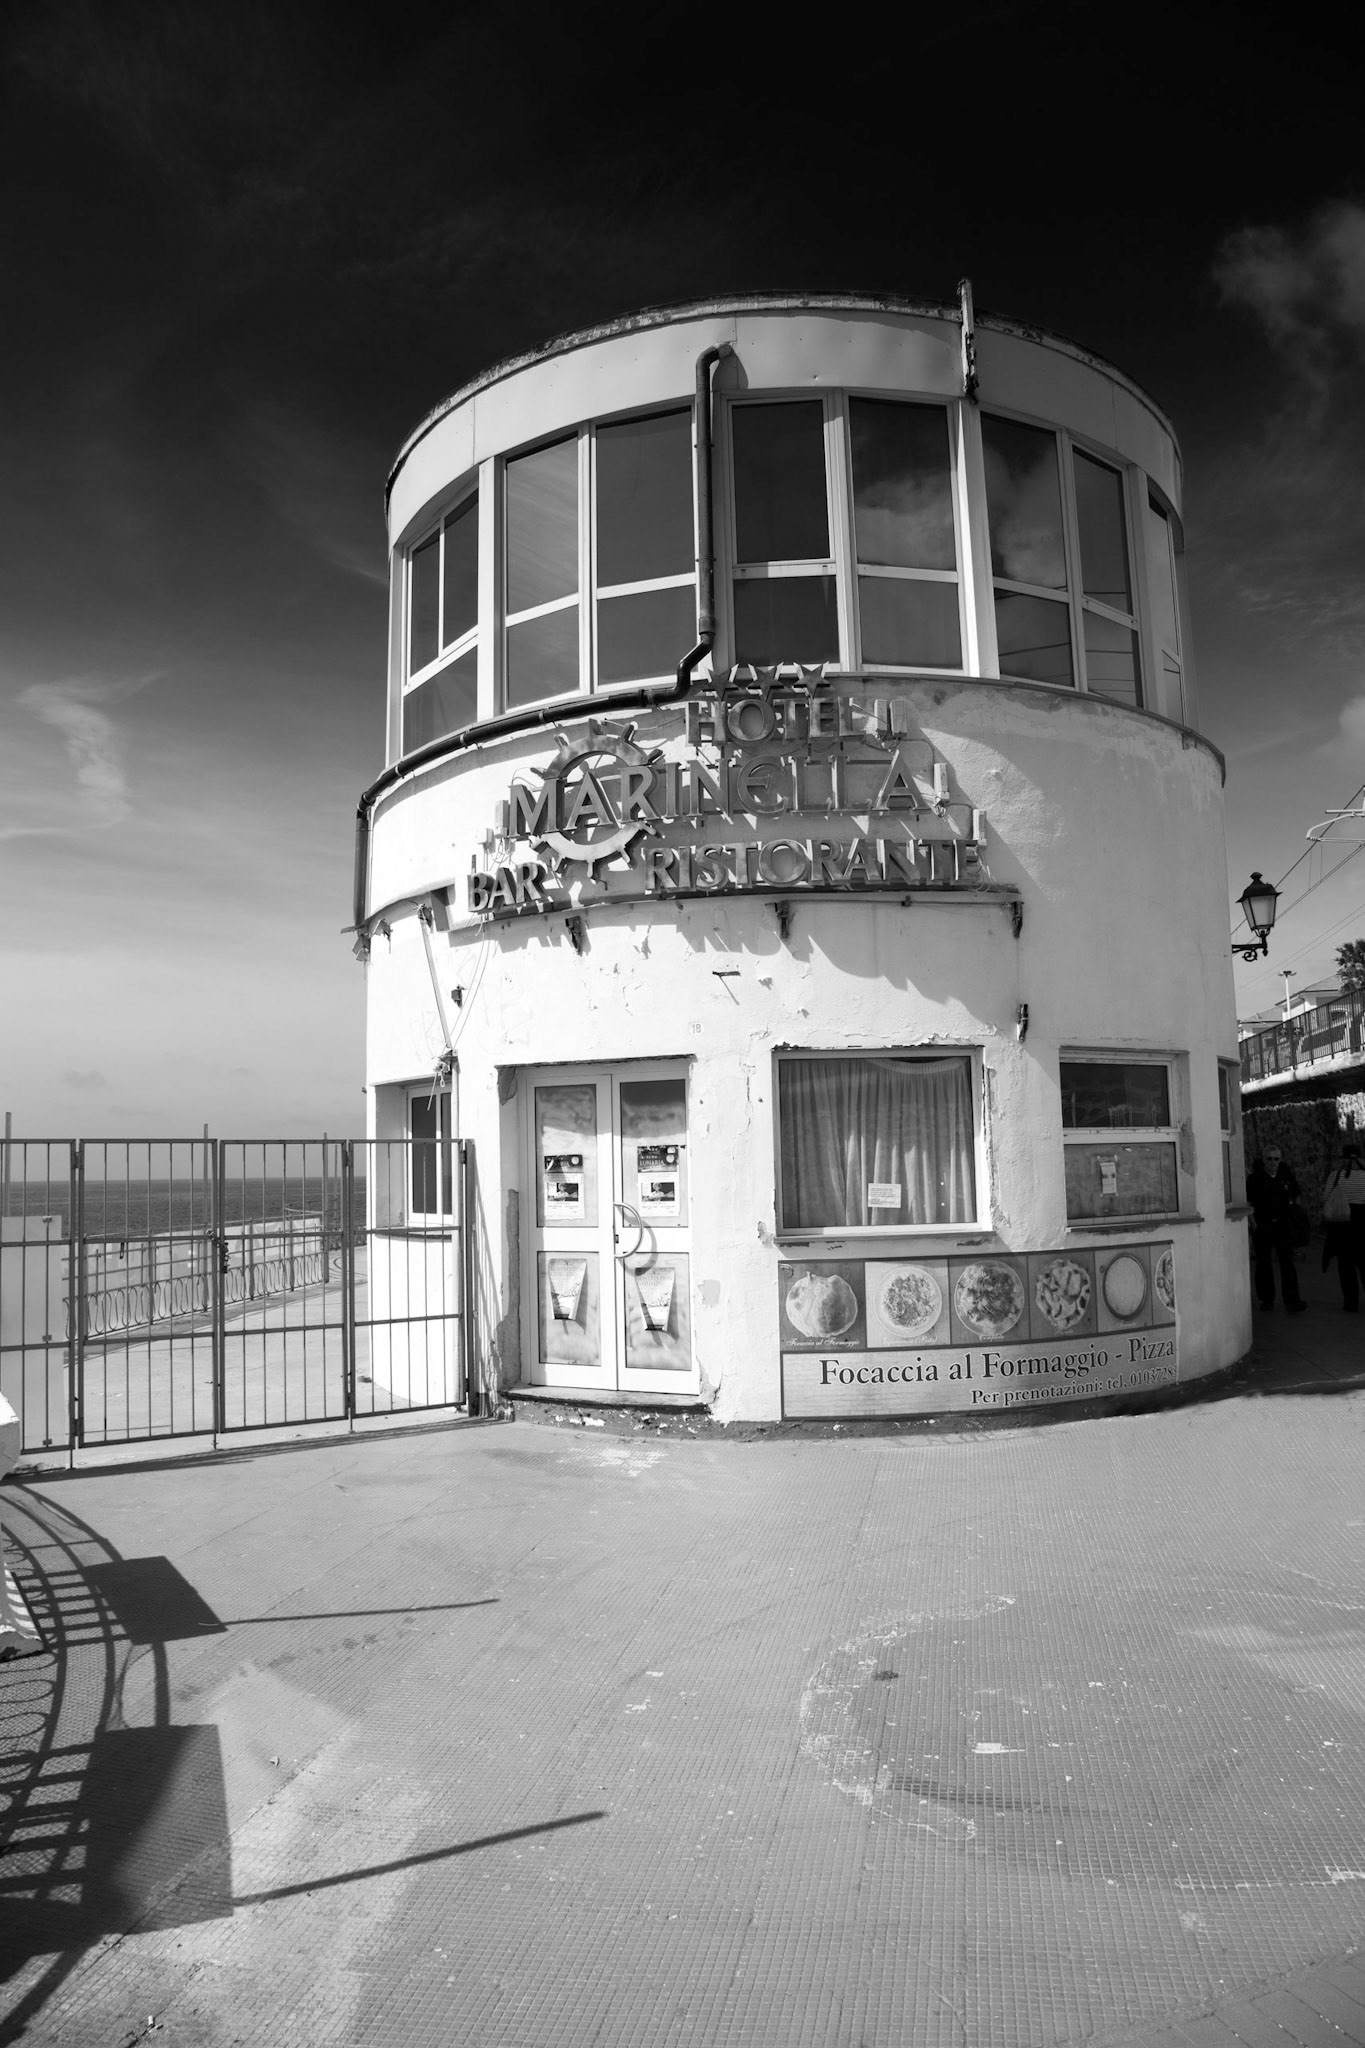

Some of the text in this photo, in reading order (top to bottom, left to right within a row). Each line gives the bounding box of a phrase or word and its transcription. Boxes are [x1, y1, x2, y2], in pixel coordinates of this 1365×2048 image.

[686, 696, 866, 747] HOTEL
[508, 749, 931, 839] MARINELLA
[468, 861, 547, 913] BAR
[645, 838, 982, 894] RISTORANTE
[819, 1355, 939, 1386] Focaccia
[948, 1352, 972, 1381] al
[981, 1344, 1108, 1382] Formaggio
[1128, 1336, 1174, 1363] Pizza
[970, 1387, 998, 1405] Per
[1003, 1377, 1103, 1407] prenotazioni:
[1106, 1373, 1128, 1392] tel.
